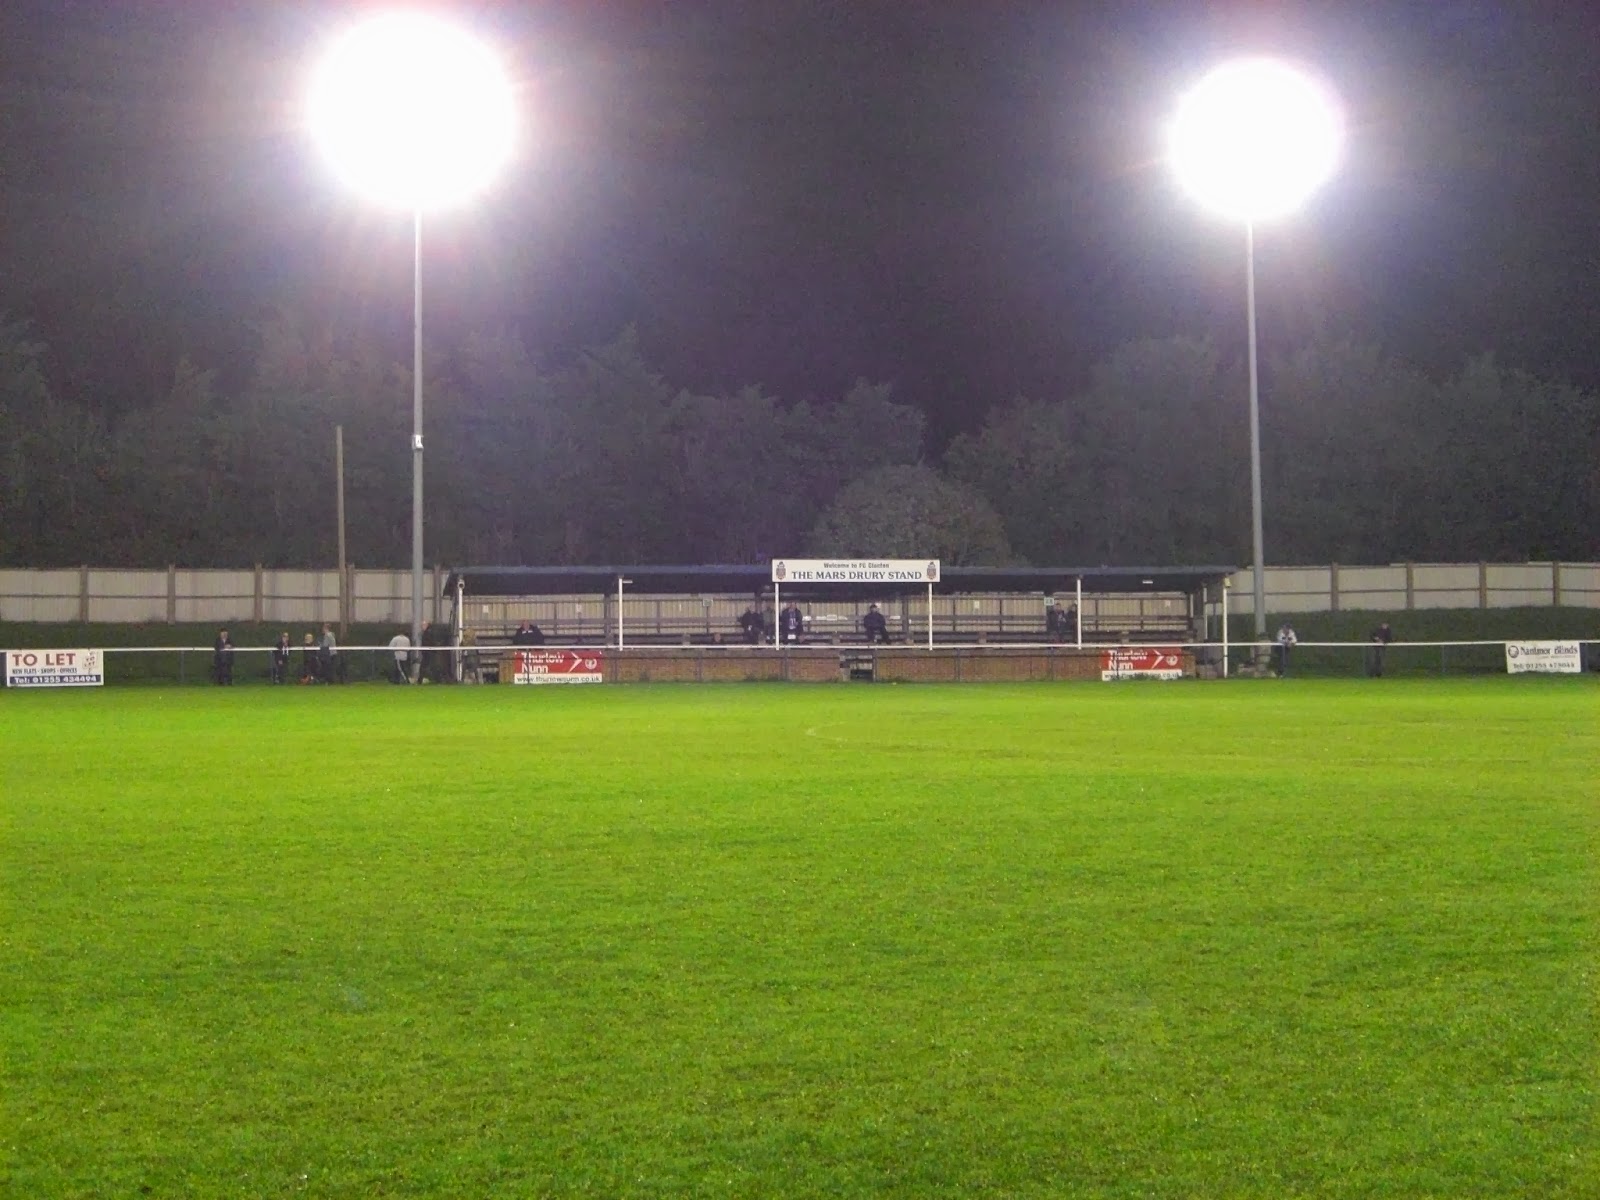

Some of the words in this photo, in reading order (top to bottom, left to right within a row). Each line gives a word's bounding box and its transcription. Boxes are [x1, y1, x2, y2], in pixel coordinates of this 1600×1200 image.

[791, 571, 813, 579] THE
[815, 571, 846, 579] MARS
[849, 571, 885, 579] DRURY
[888, 571, 922, 579] STAND
[12, 653, 38, 666] TO
[45, 653, 76, 666] LET
[521, 651, 565, 664] Thurlow
[521, 663, 549, 674] Nunn
